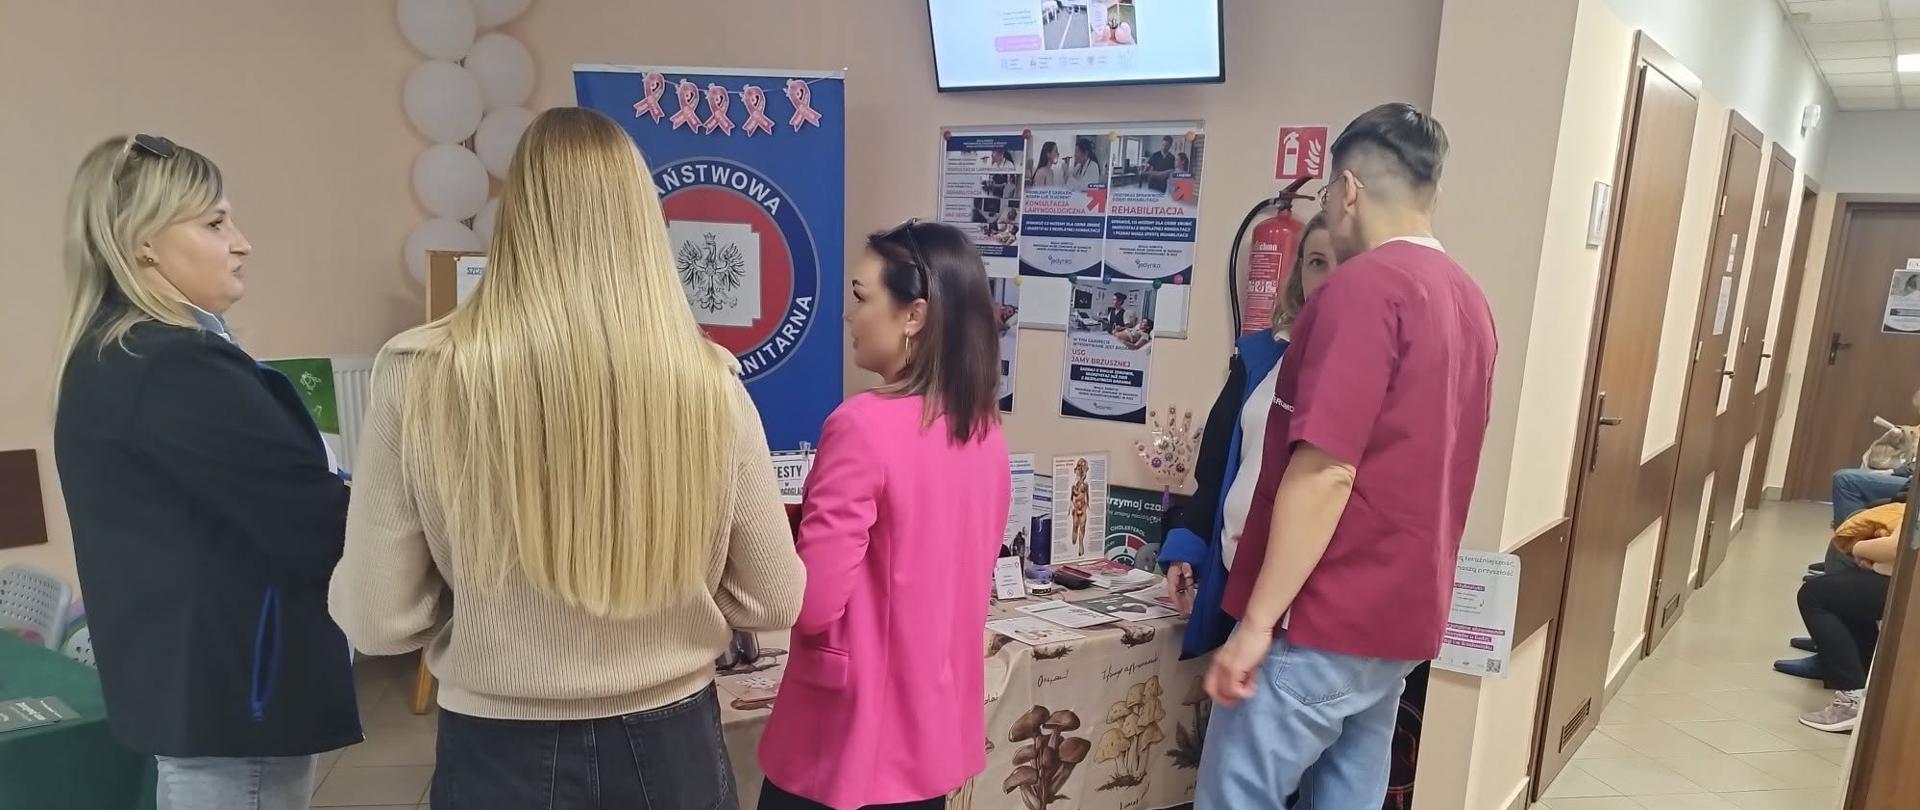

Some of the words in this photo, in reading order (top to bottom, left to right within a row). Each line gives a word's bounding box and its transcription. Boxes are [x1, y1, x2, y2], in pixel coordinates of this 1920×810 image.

[655, 164, 780, 215] ŃSTWOWA
[1111, 205, 1184, 216] REHABILITACJA
[740, 296, 812, 376] NITARNA
[1071, 356, 1090, 364] JAMY
[1091, 358, 1131, 368] BRZUSZNEJ
[773, 464, 802, 478] ESTY
[1109, 497, 1142, 511] rzymaj
[1110, 525, 1145, 536] CHOLESTEROL
